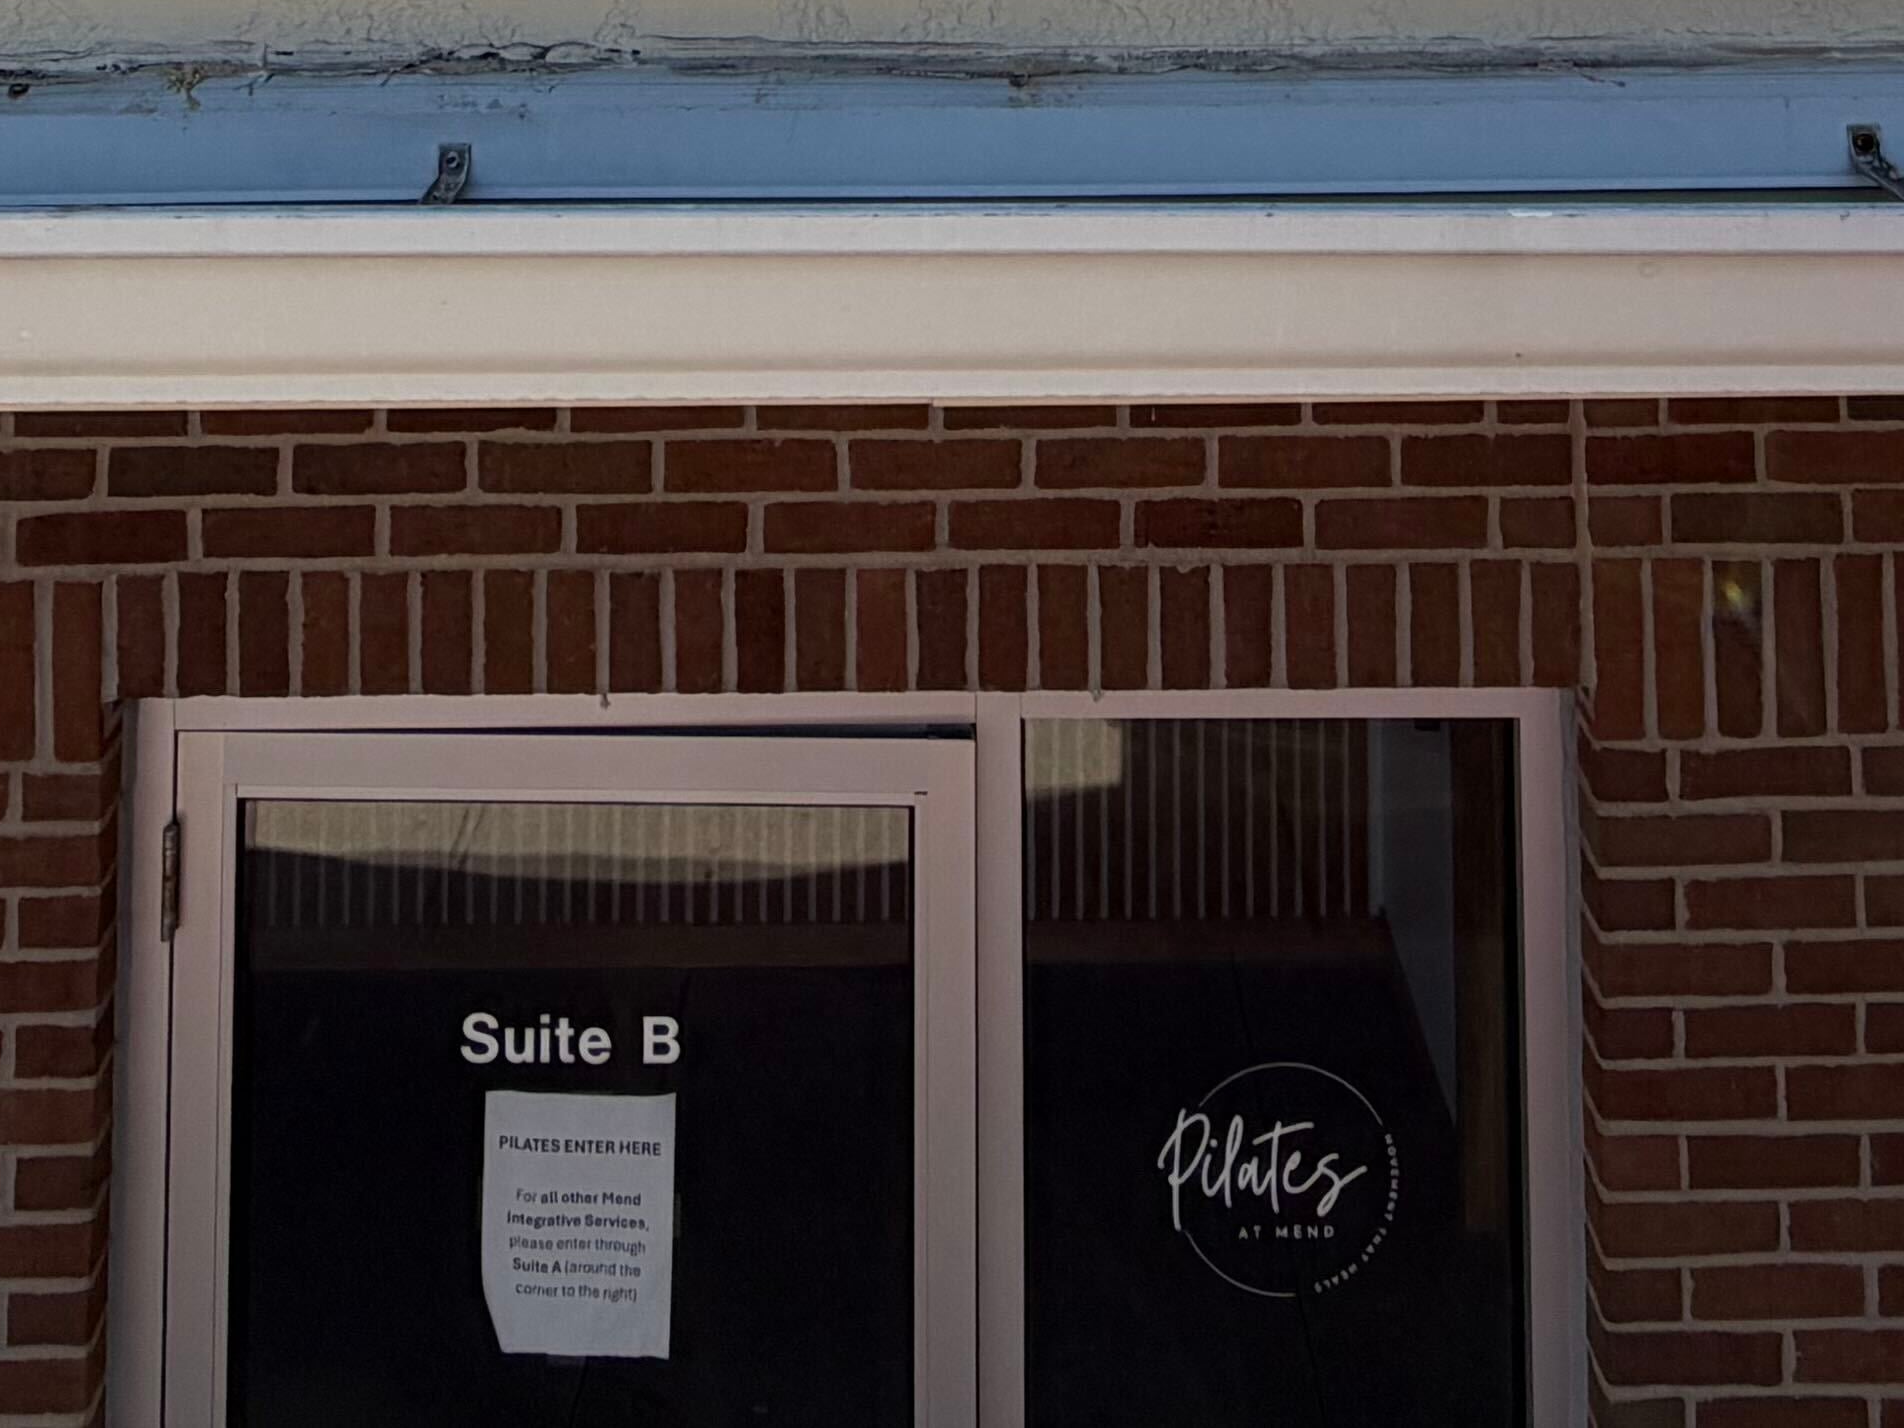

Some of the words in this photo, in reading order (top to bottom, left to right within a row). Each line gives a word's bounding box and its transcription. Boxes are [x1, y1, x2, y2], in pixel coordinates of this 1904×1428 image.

[460, 1012, 612, 1065] Suite
[642, 1015, 681, 1064] B
[498, 1135, 561, 1153] PILATES
[564, 1139, 615, 1155] ENTER
[619, 1140, 662, 1156] HERE
[1156, 1107, 1369, 1232] Pilates
[516, 1188, 537, 1202] For
[540, 1190, 559, 1204] all
[561, 1191, 598, 1205] other
[602, 1192, 641, 1206] Mend
[507, 1210, 581, 1229] Integrative
[1238, 1224, 1262, 1240] AT
[1275, 1223, 1336, 1240] MEND
[509, 1235, 553, 1251] please
[556, 1238, 591, 1251] enter
[594, 1238, 645, 1256] through
[512, 1257, 548, 1273] Suite
[551, 1260, 562, 1274] A
[564, 1260, 616, 1276] (around
[620, 1263, 641, 1278] the
[515, 1283, 558, 1298] corner
[562, 1285, 576, 1298] to
[579, 1285, 600, 1299] the
[603, 1287, 637, 1303] right)
